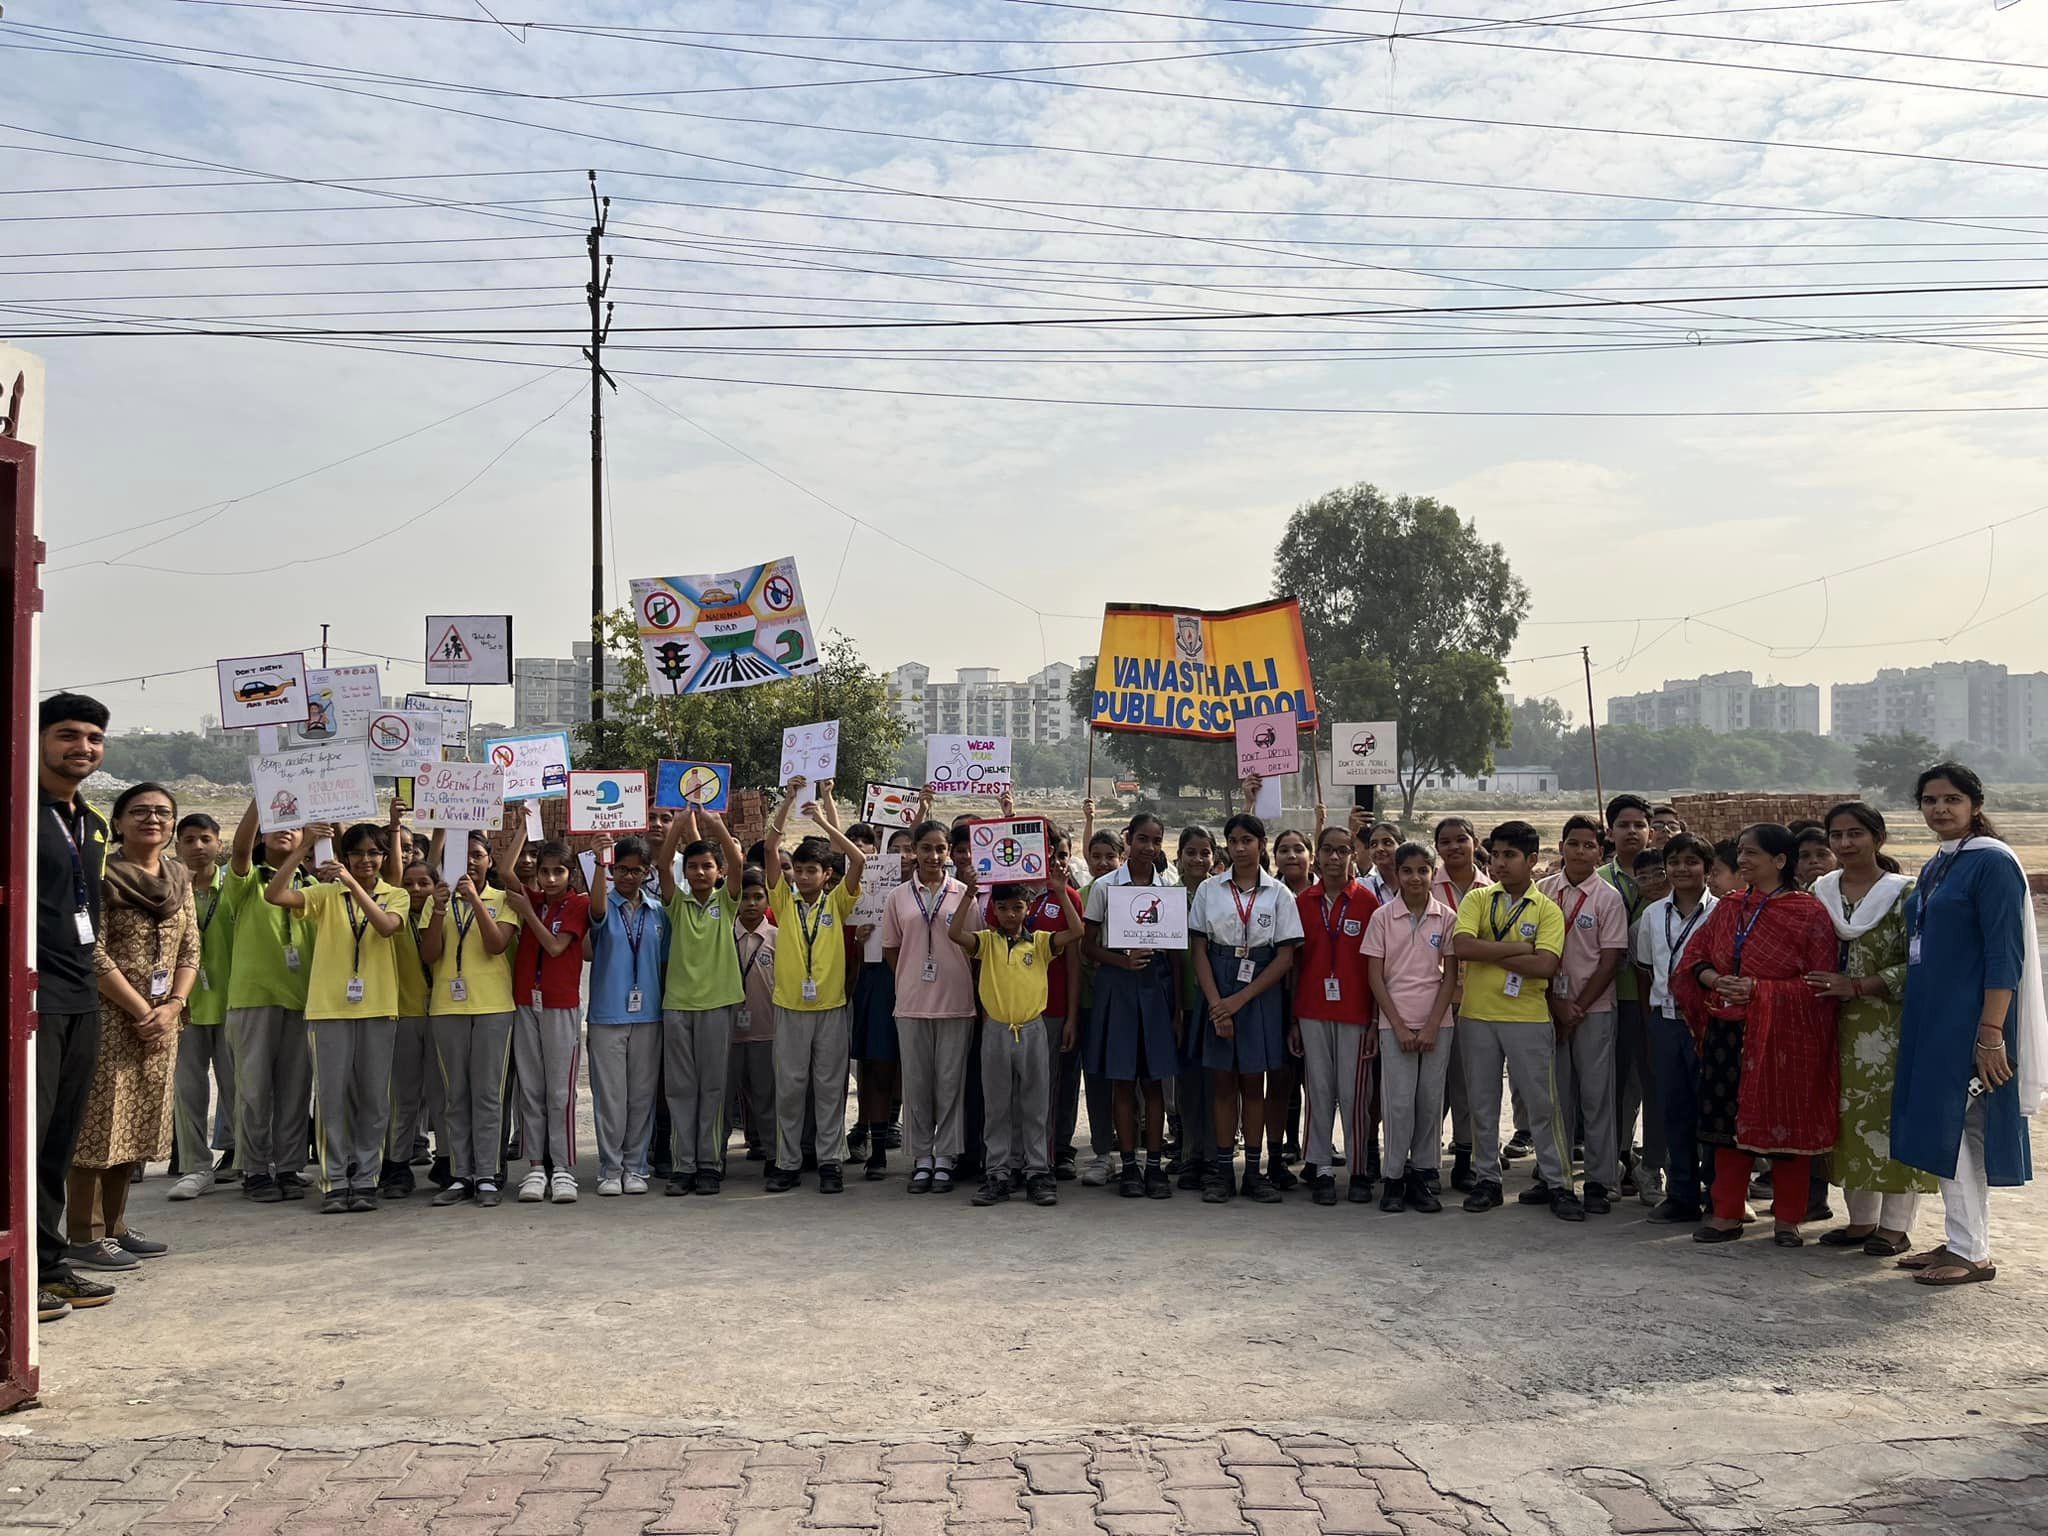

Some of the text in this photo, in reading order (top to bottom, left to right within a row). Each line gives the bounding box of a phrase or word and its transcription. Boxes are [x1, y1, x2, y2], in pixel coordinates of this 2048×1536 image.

[713, 623, 738, 632] ROAD
[1114, 656, 1279, 697] VANASTHALI
[1091, 689, 1315, 731] PUBLIC SCHOOL
[967, 740, 995, 751] WEAR
[984, 766, 1010, 774] HELMET
[624, 785, 642, 795] WEAR
[929, 780, 970, 792] SAFETY
[594, 811, 623, 820] HELMET
[590, 820, 637, 829] & SEAT BELT
